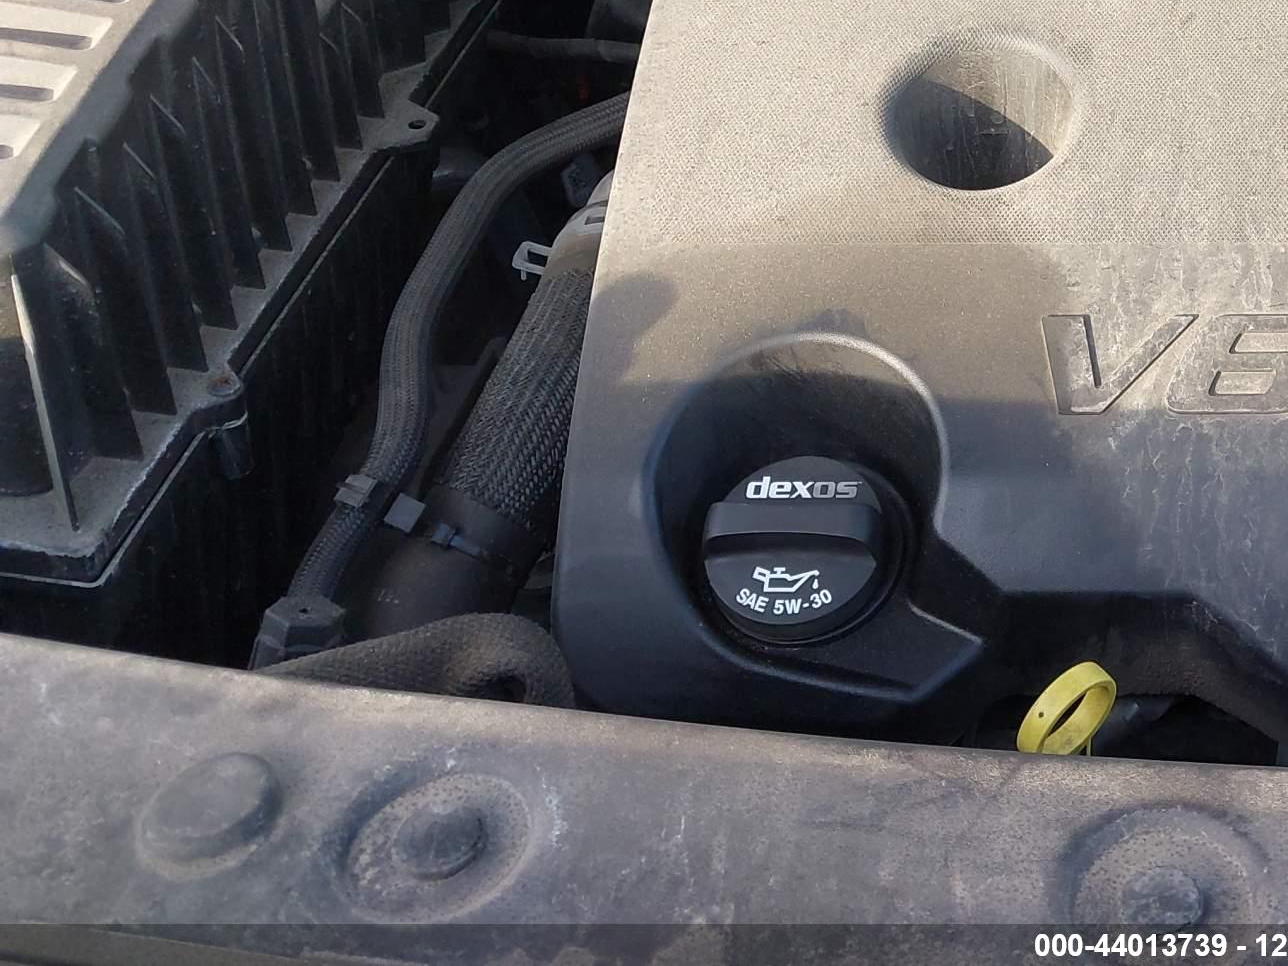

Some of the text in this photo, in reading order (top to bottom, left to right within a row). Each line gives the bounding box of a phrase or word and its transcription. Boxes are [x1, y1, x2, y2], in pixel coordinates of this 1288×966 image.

[745, 475, 858, 500] dexos
[735, 587, 833, 616] SAE 5W-30
